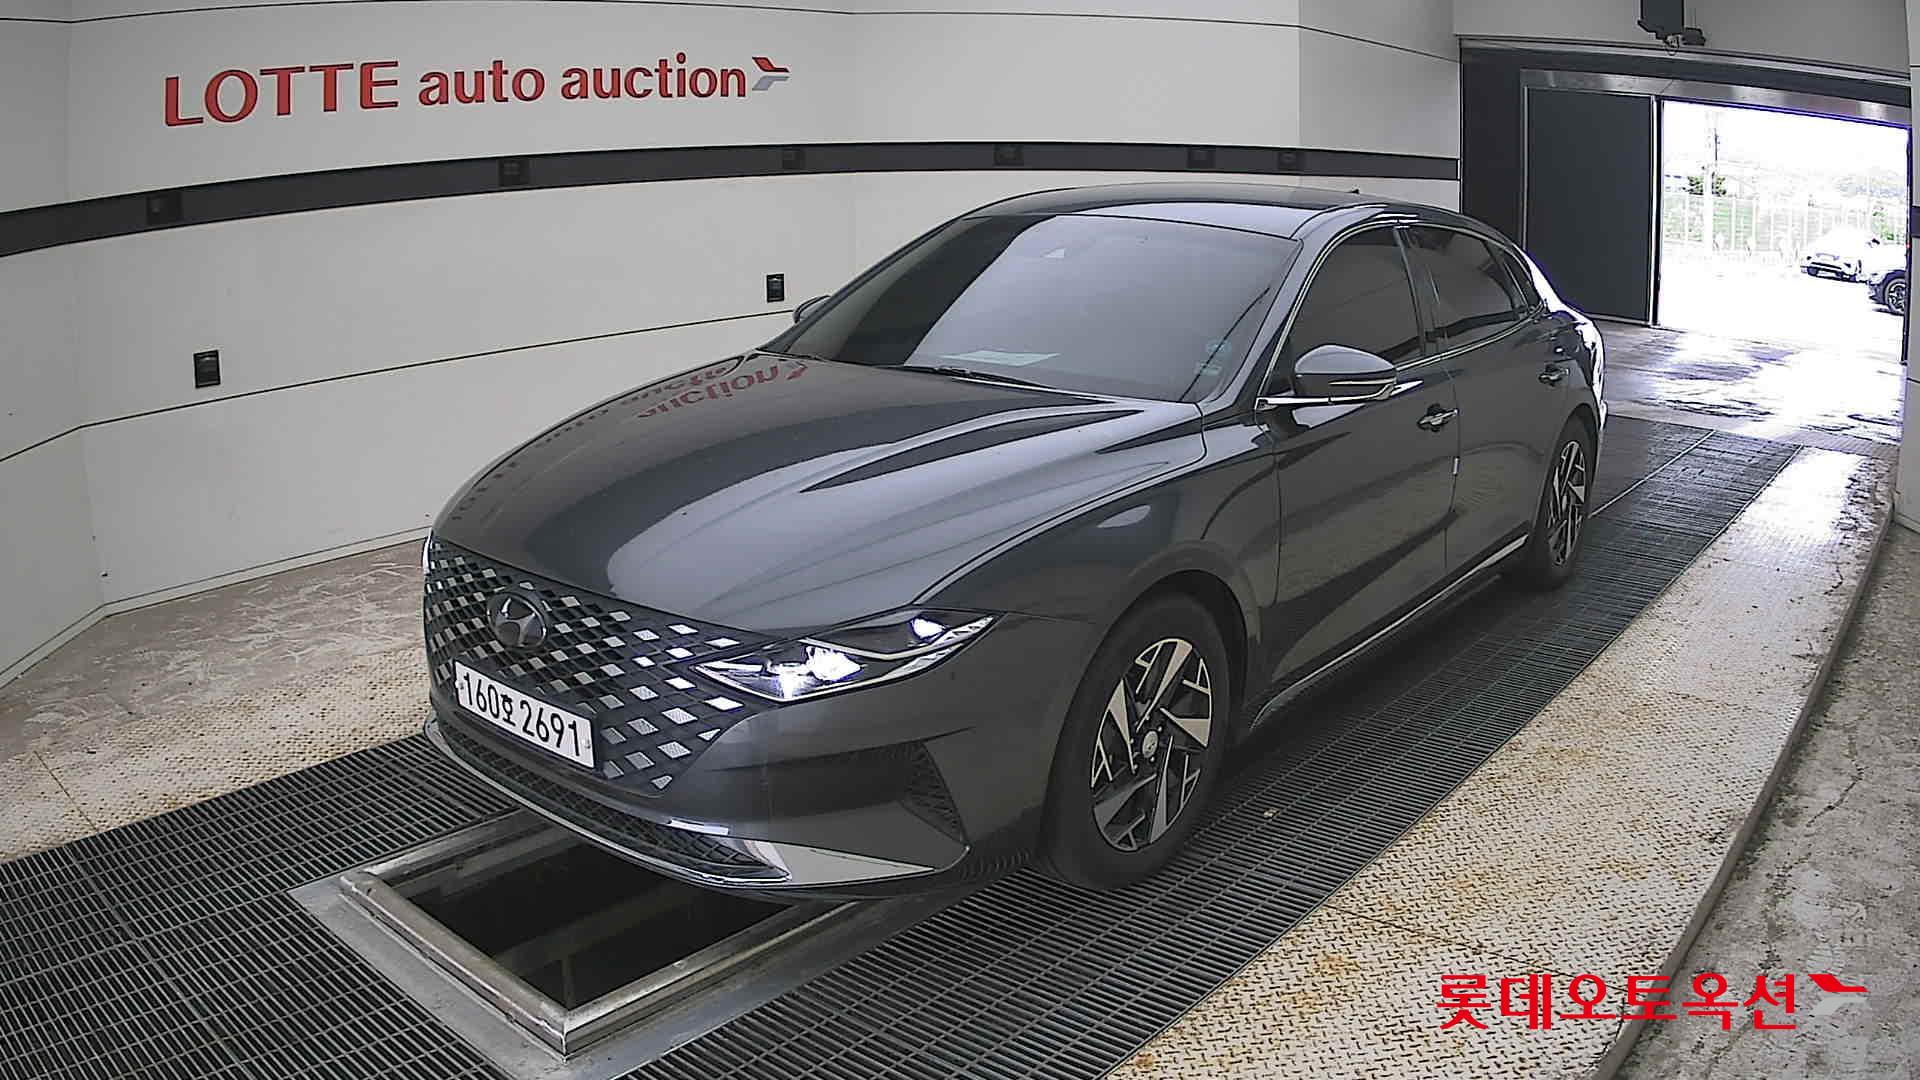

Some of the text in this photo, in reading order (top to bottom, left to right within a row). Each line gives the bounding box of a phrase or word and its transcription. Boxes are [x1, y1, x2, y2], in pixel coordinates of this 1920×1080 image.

[164, 52, 747, 127] LOTTE auto auction
